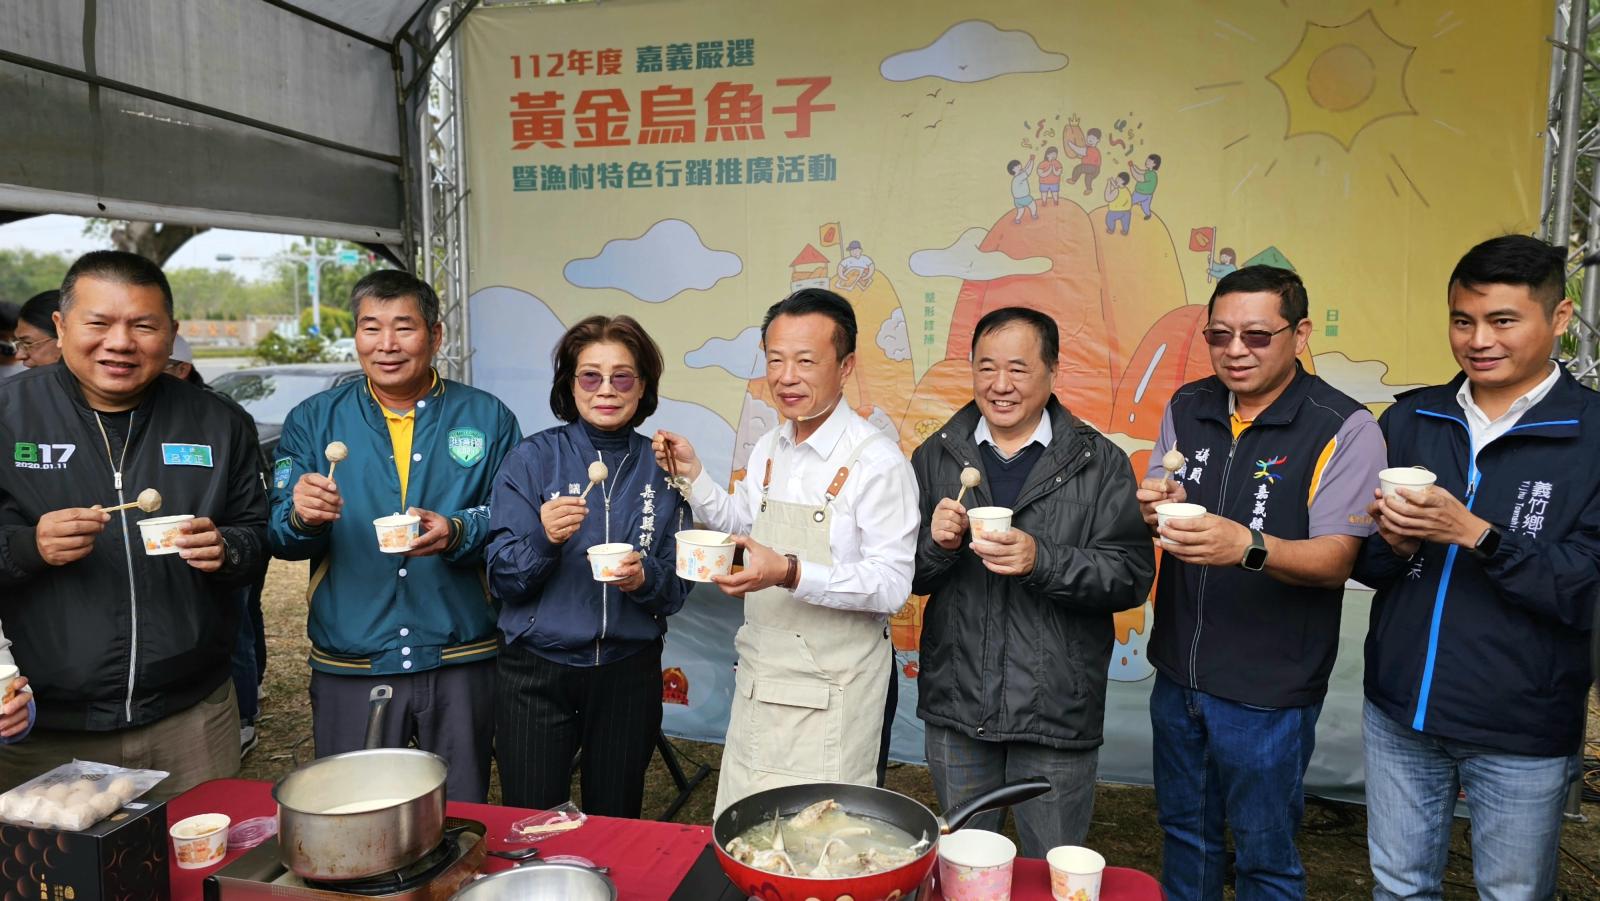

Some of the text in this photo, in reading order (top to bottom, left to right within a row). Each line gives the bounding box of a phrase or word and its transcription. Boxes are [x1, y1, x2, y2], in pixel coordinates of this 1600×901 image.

[510, 38, 755, 79] 112年度 嘉義嚴選
[509, 75, 837, 151] 黃金烏魚子
[512, 153, 838, 192] 暨漁村特色行銷推廣活動
